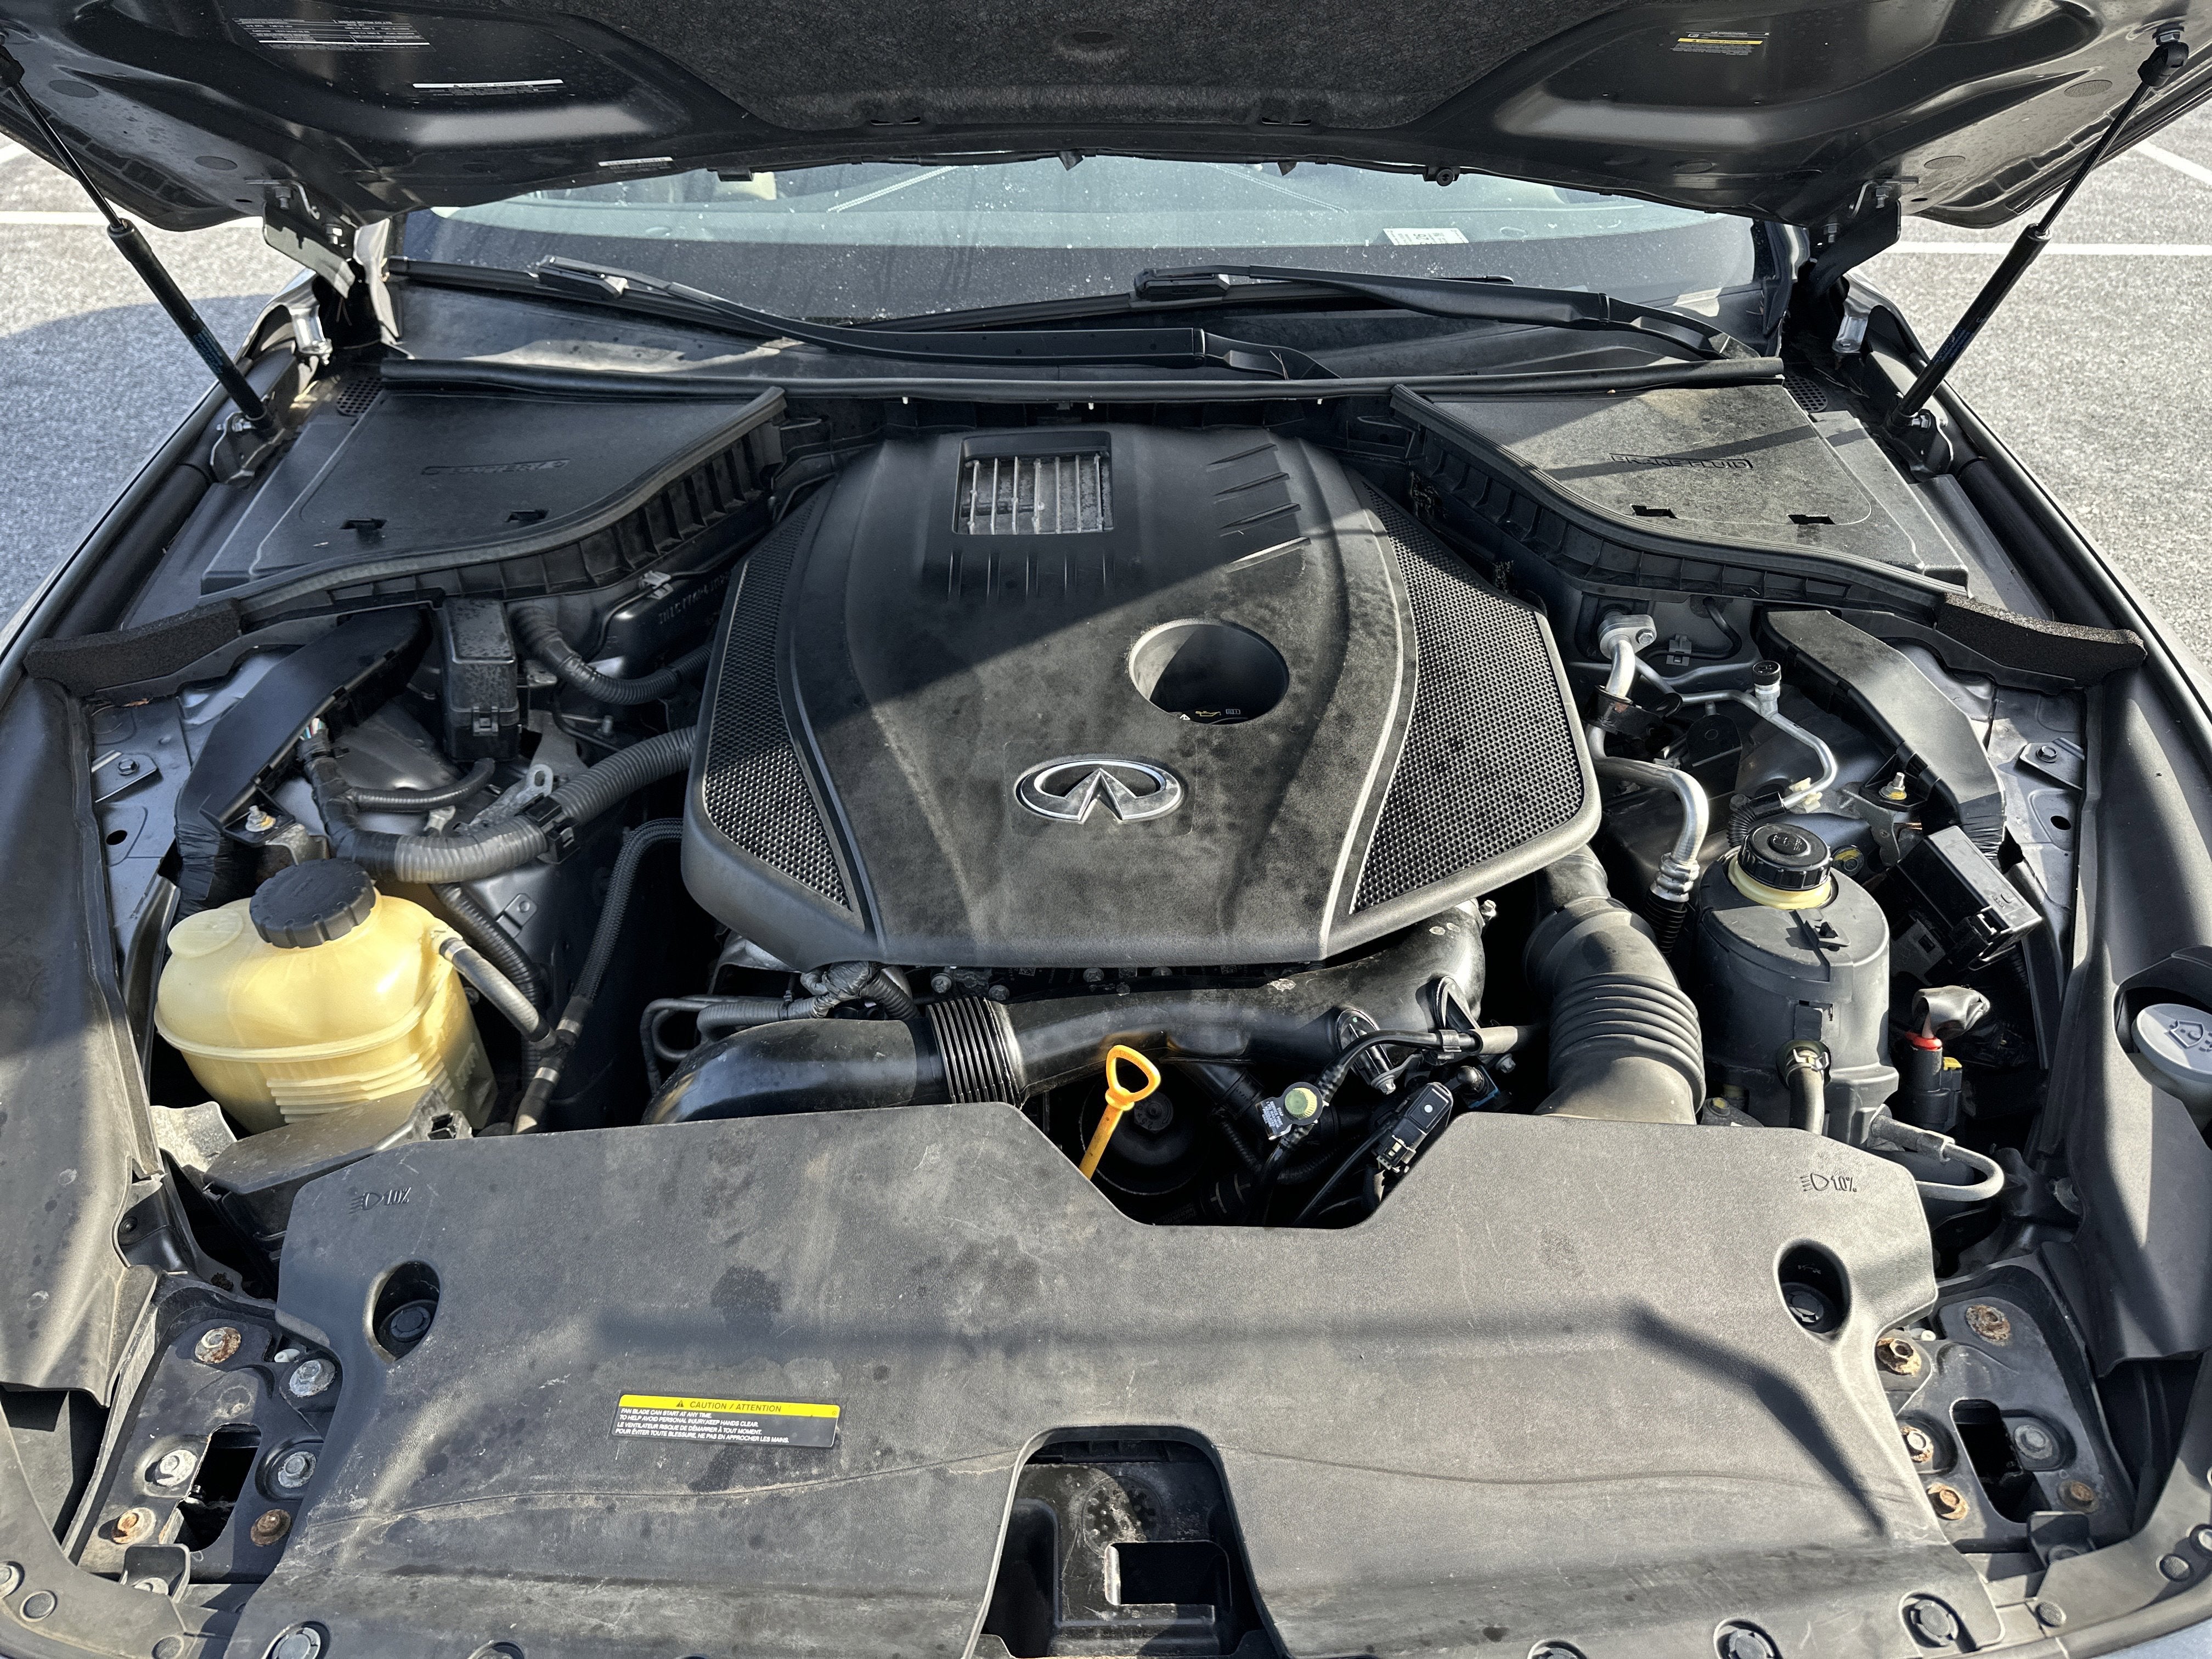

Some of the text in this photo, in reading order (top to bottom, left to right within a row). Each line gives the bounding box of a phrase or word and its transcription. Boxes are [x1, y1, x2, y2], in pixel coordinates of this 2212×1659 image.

[1611, 455, 1747, 469] BRAKE FLUID
[690, 1401, 726, 1409] CAUTION
[736, 1403, 782, 1412] ATTENTION
